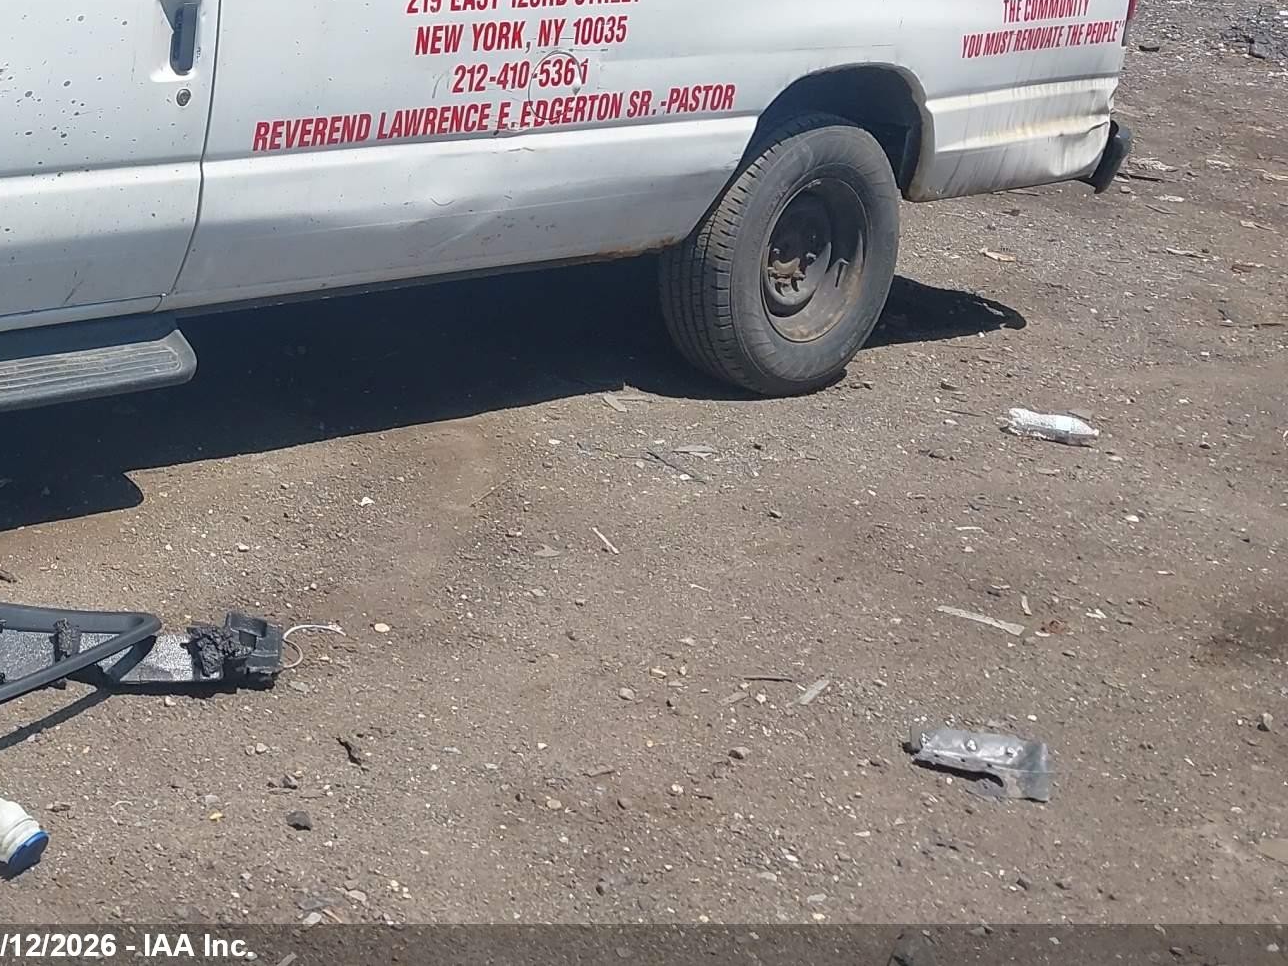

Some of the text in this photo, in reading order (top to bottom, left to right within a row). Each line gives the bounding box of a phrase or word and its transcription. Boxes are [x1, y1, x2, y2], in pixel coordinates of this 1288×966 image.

[415, 16, 628, 55] NEW YORK, NY 10035
[962, 32, 984, 58] YOU
[983, 29, 1016, 56] MUST
[1014, 25, 1064, 52] RENOVATE
[1064, 23, 1085, 46] THE
[452, 58, 588, 94] 212-410-5361
[253, 114, 372, 151] REVEREND
[377, 103, 491, 140] LAWRENCE
